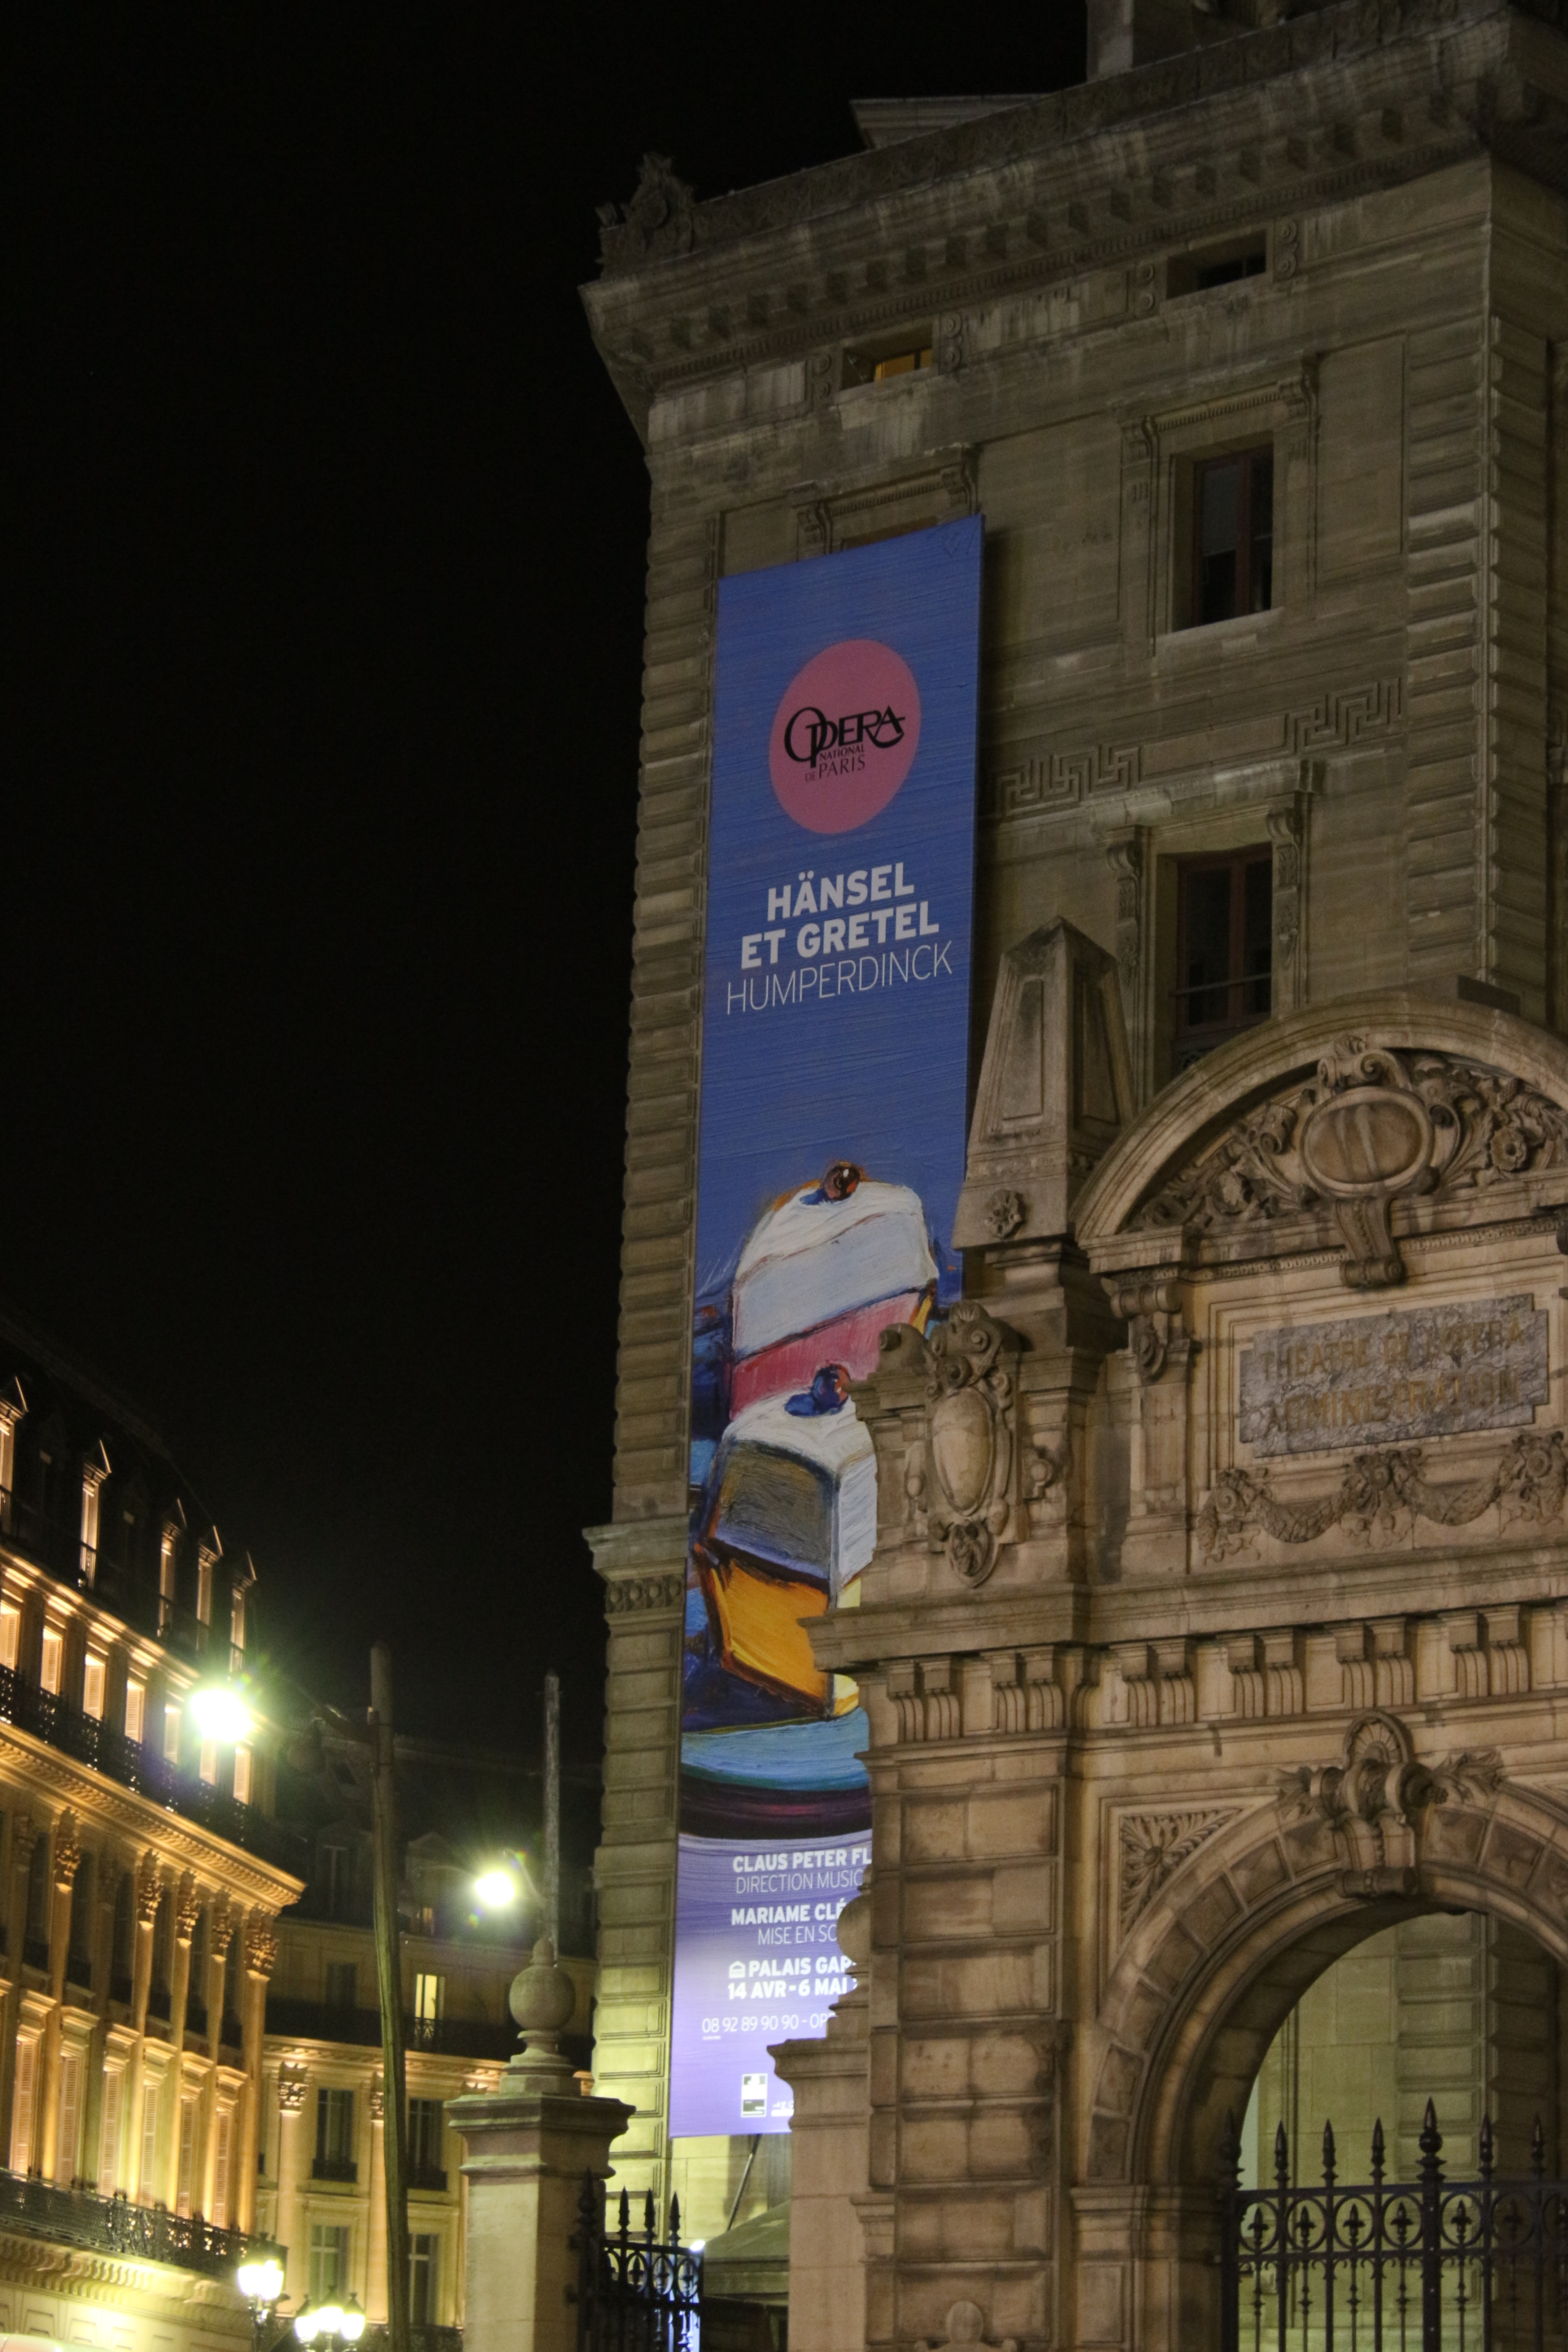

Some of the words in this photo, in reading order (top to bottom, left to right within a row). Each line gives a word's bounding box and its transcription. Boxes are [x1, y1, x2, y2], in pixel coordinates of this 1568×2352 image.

[820, 744, 865, 761] NATIONAL
[805, 771, 817, 782] DE
[819, 754, 866, 779] PARIS
[767, 862, 915, 922] HÄNSEL
[741, 928, 787, 970] ET
[797, 901, 940, 959] GRETEL
[727, 940, 952, 1015] HUMPERDINCK
[733, 1853, 788, 1873] CLAUS
[793, 1850, 847, 1869] PETER
[736, 1872, 813, 1894] DIRECTION
[731, 1904, 810, 1926] MARIAME
[758, 1926, 792, 1945] MISE
[796, 1926, 814, 1943] EN
[749, 1957, 811, 1977] PALAIS
[728, 1983, 746, 1999] 14
[815, 1978, 847, 1995] MAI
[702, 2018, 720, 2033] 08
[722, 2017, 738, 2032] 92
[741, 2016, 757, 2031] 89
[761, 2015, 778, 2030] 90
[781, 2014, 799, 2029] 90
